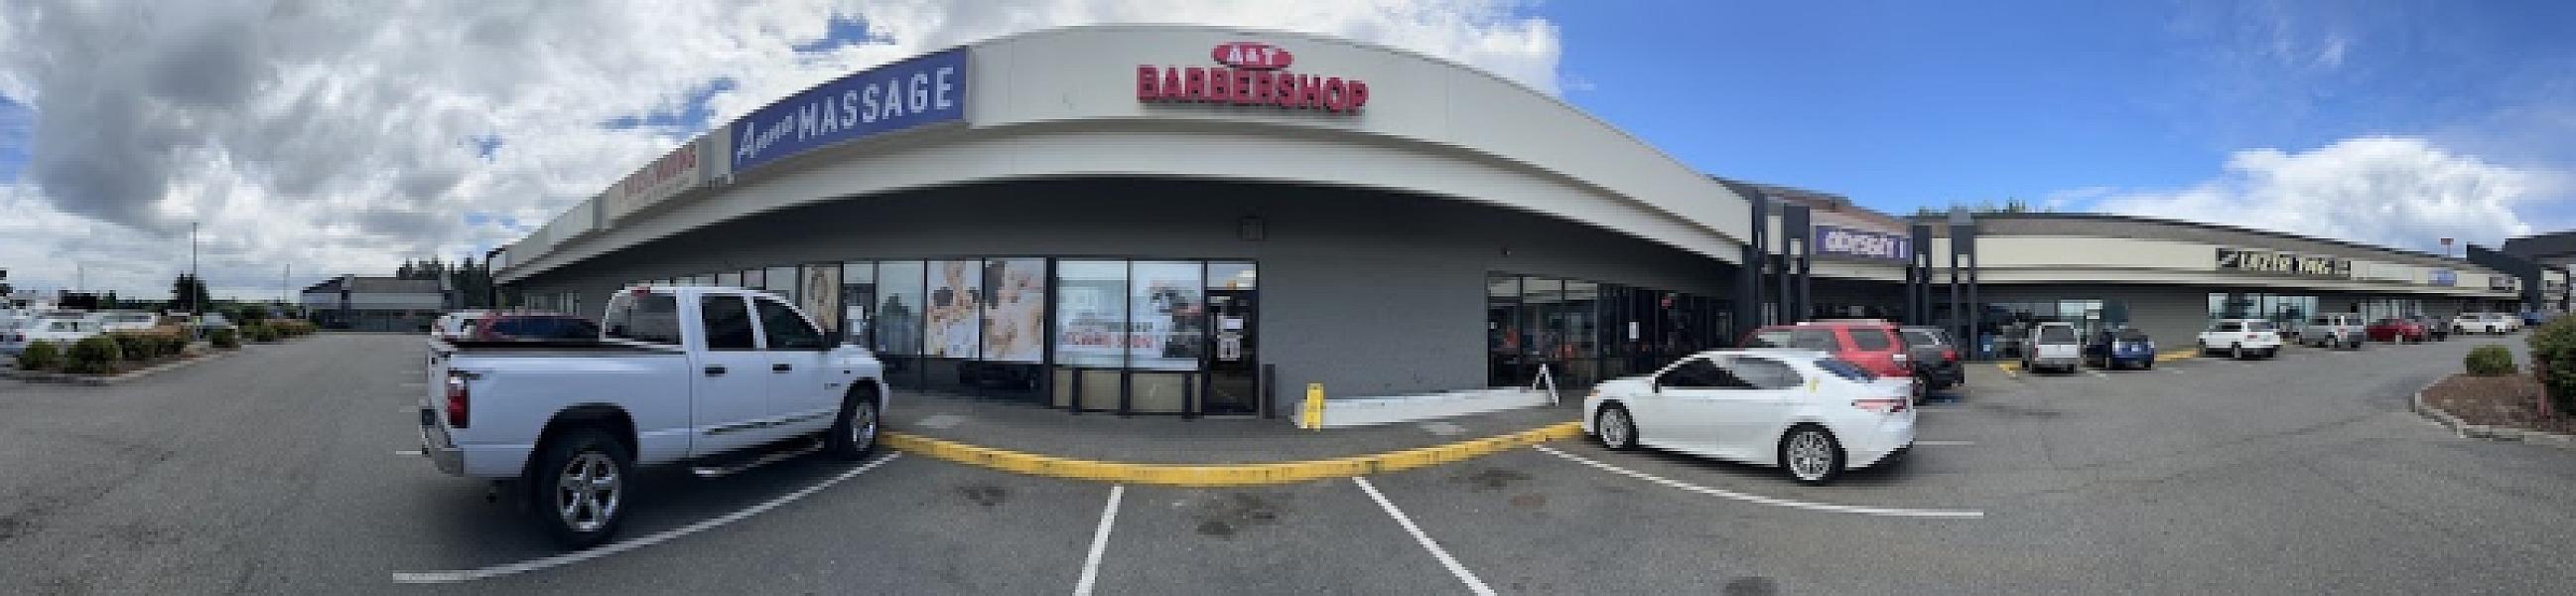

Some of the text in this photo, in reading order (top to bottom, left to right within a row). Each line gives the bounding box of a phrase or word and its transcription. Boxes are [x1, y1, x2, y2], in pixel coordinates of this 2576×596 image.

[1226, 48, 1278, 67] A&T
[1137, 66, 1369, 114] BARBERSHOP
[738, 67, 954, 165] Anna MASSAGE
